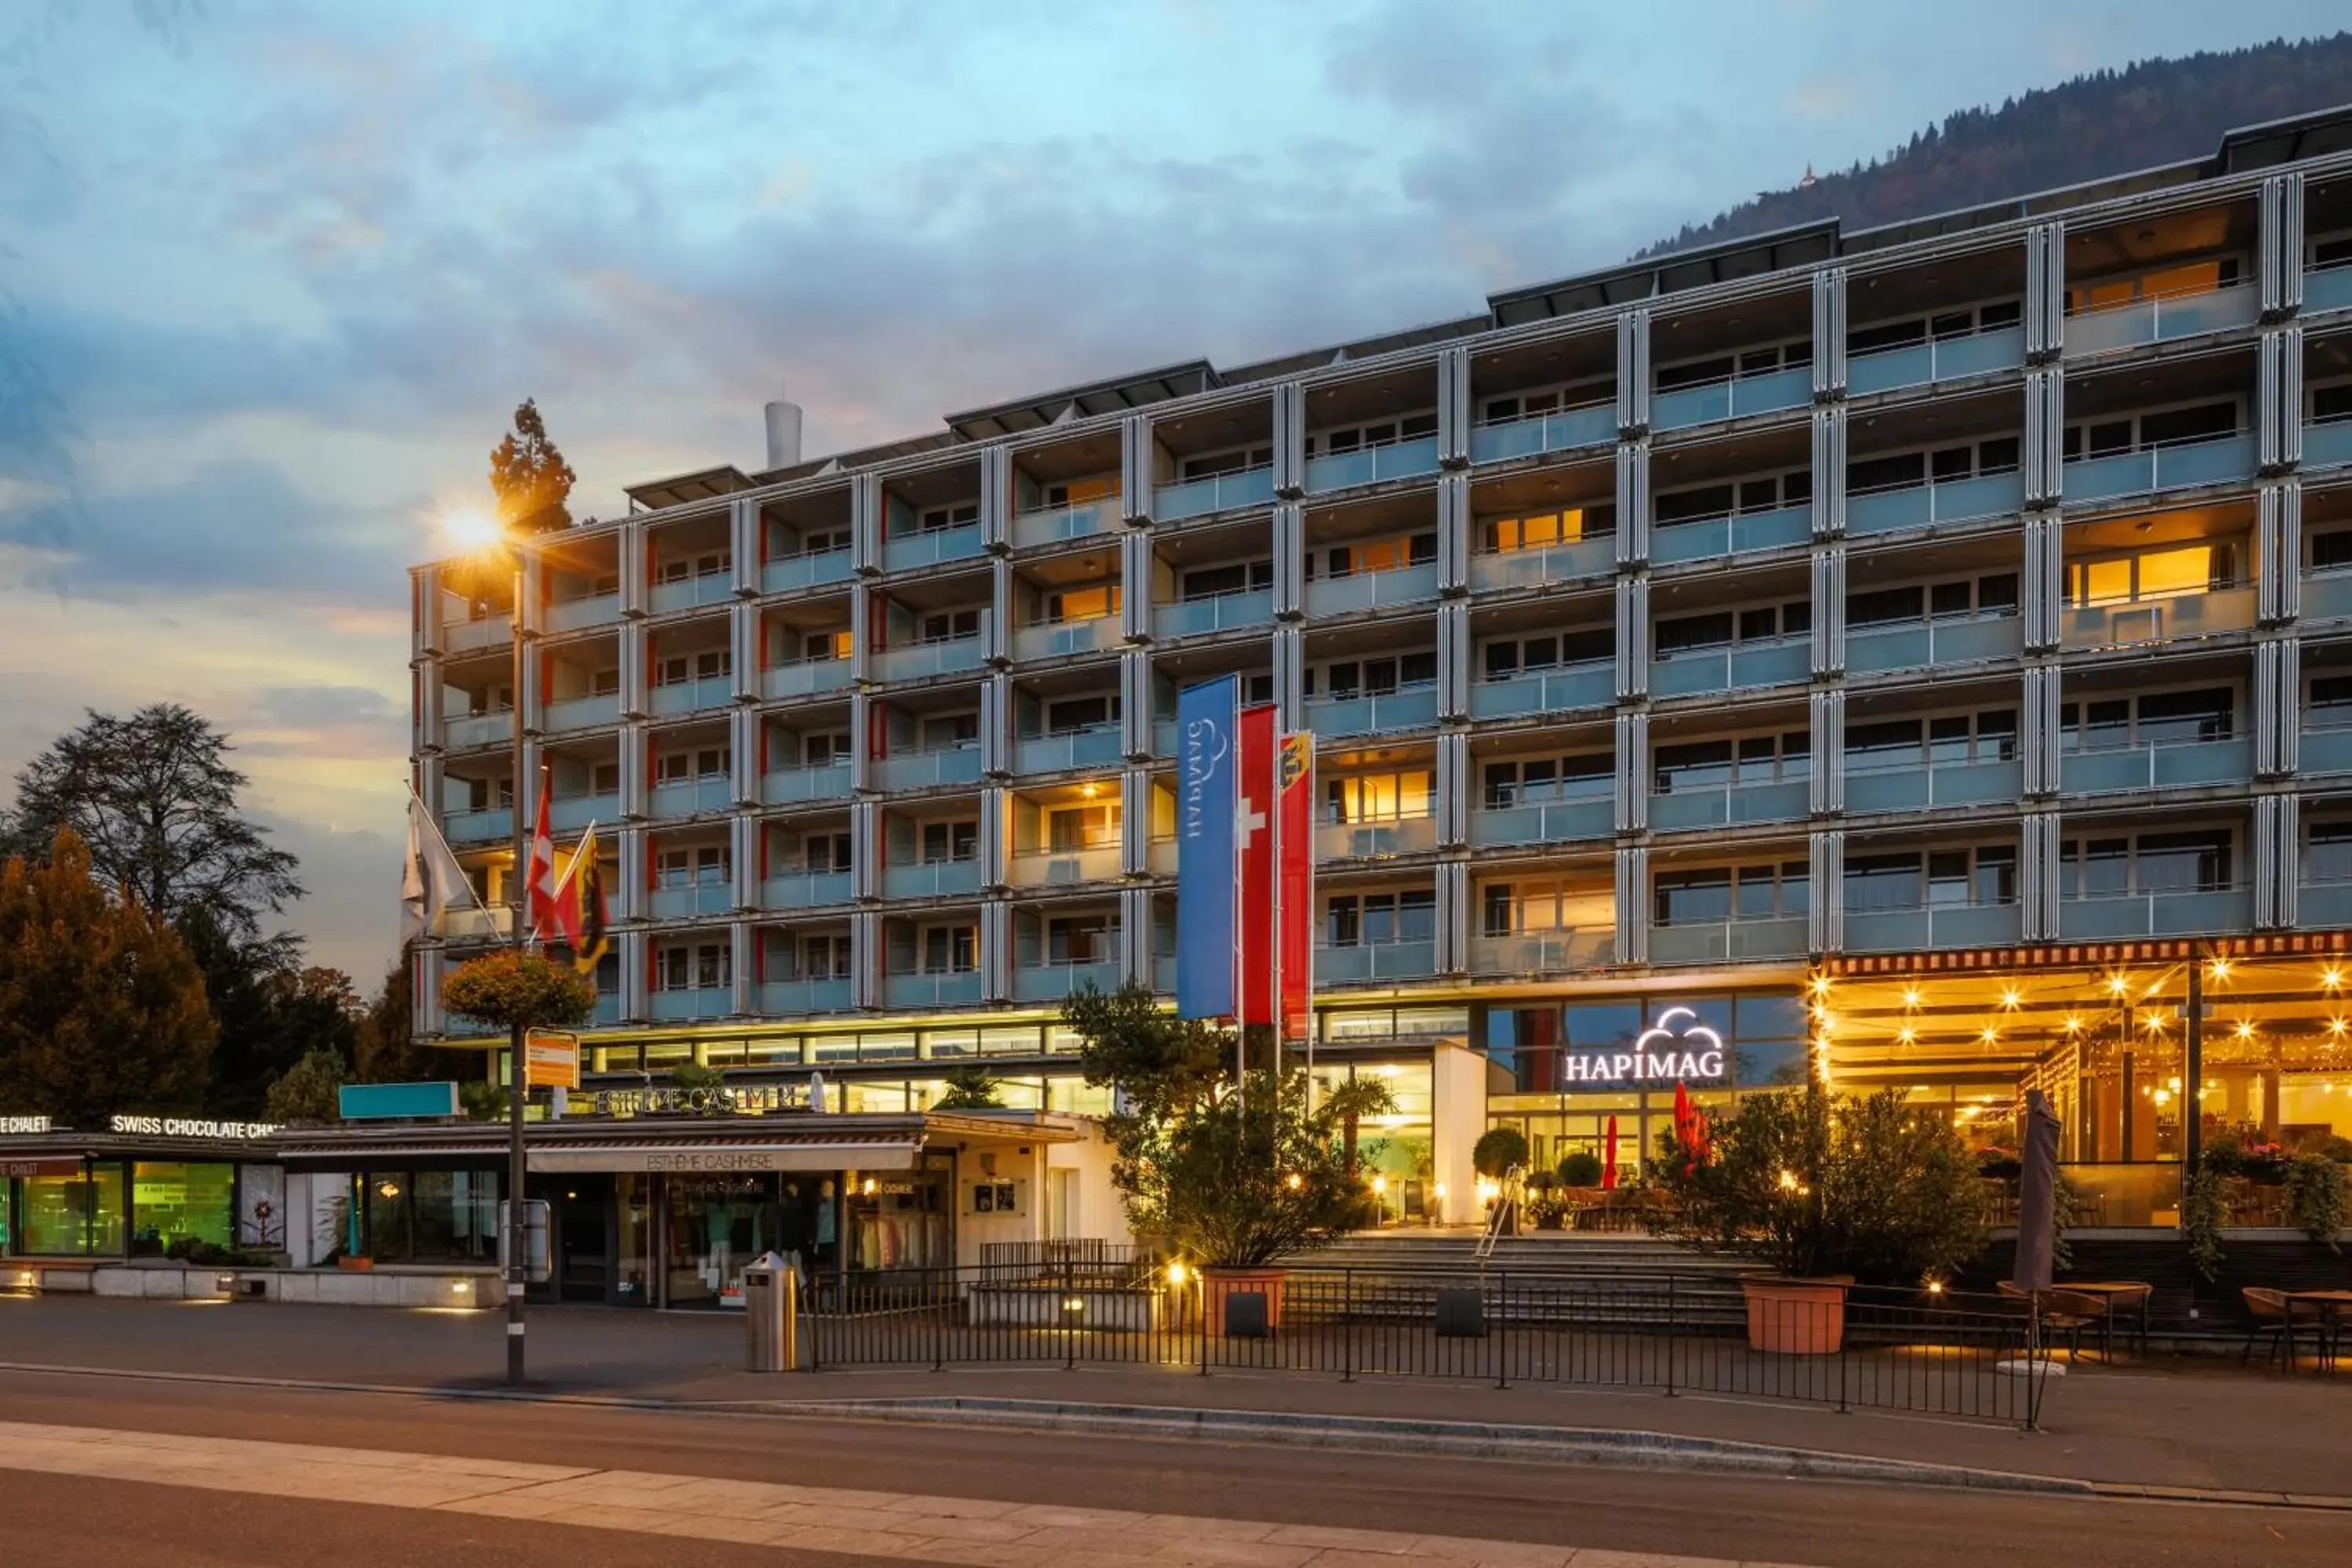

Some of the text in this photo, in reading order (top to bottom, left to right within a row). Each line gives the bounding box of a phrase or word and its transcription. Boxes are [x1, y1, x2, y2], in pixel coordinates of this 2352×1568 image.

[1565, 1051, 1723, 1080] HAPIMAG
[9, 1116, 50, 1133] CHALET
[113, 1115, 285, 1138] SWISS CHOCOLATE CHA
[705, 1153, 774, 1170] CASHMERE
